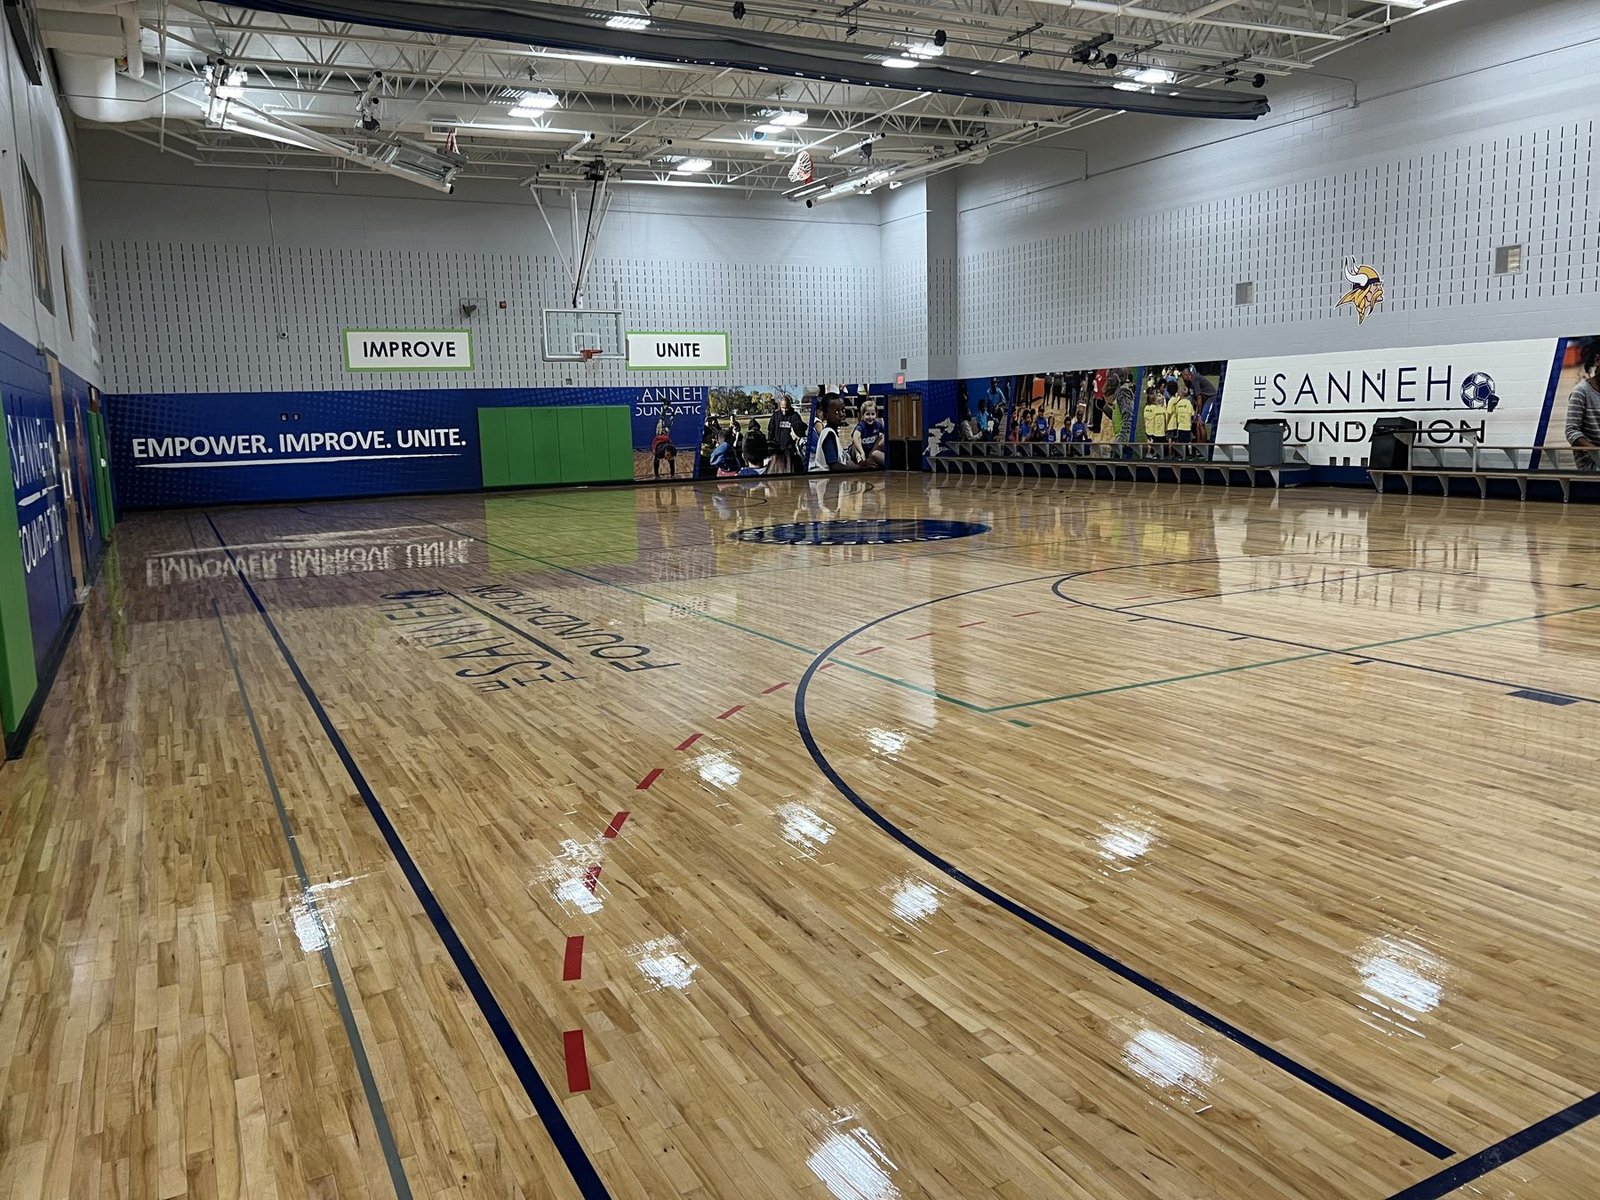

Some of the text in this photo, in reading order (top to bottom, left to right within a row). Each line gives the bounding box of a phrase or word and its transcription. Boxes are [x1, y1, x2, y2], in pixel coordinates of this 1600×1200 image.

[362, 340, 457, 359] IMPROVE
[656, 342, 701, 358] UNITE
[636, 387, 703, 402] ANNEH
[1253, 375, 1267, 409] THE
[1271, 364, 1452, 406] SANNEH
[132, 428, 467, 458] EMPOWER. IMPROVE. UNITE.
[379, 598, 552, 678] SANNEH
[463, 584, 681, 673] FOUNDATION
[472, 670, 589, 693] THE
